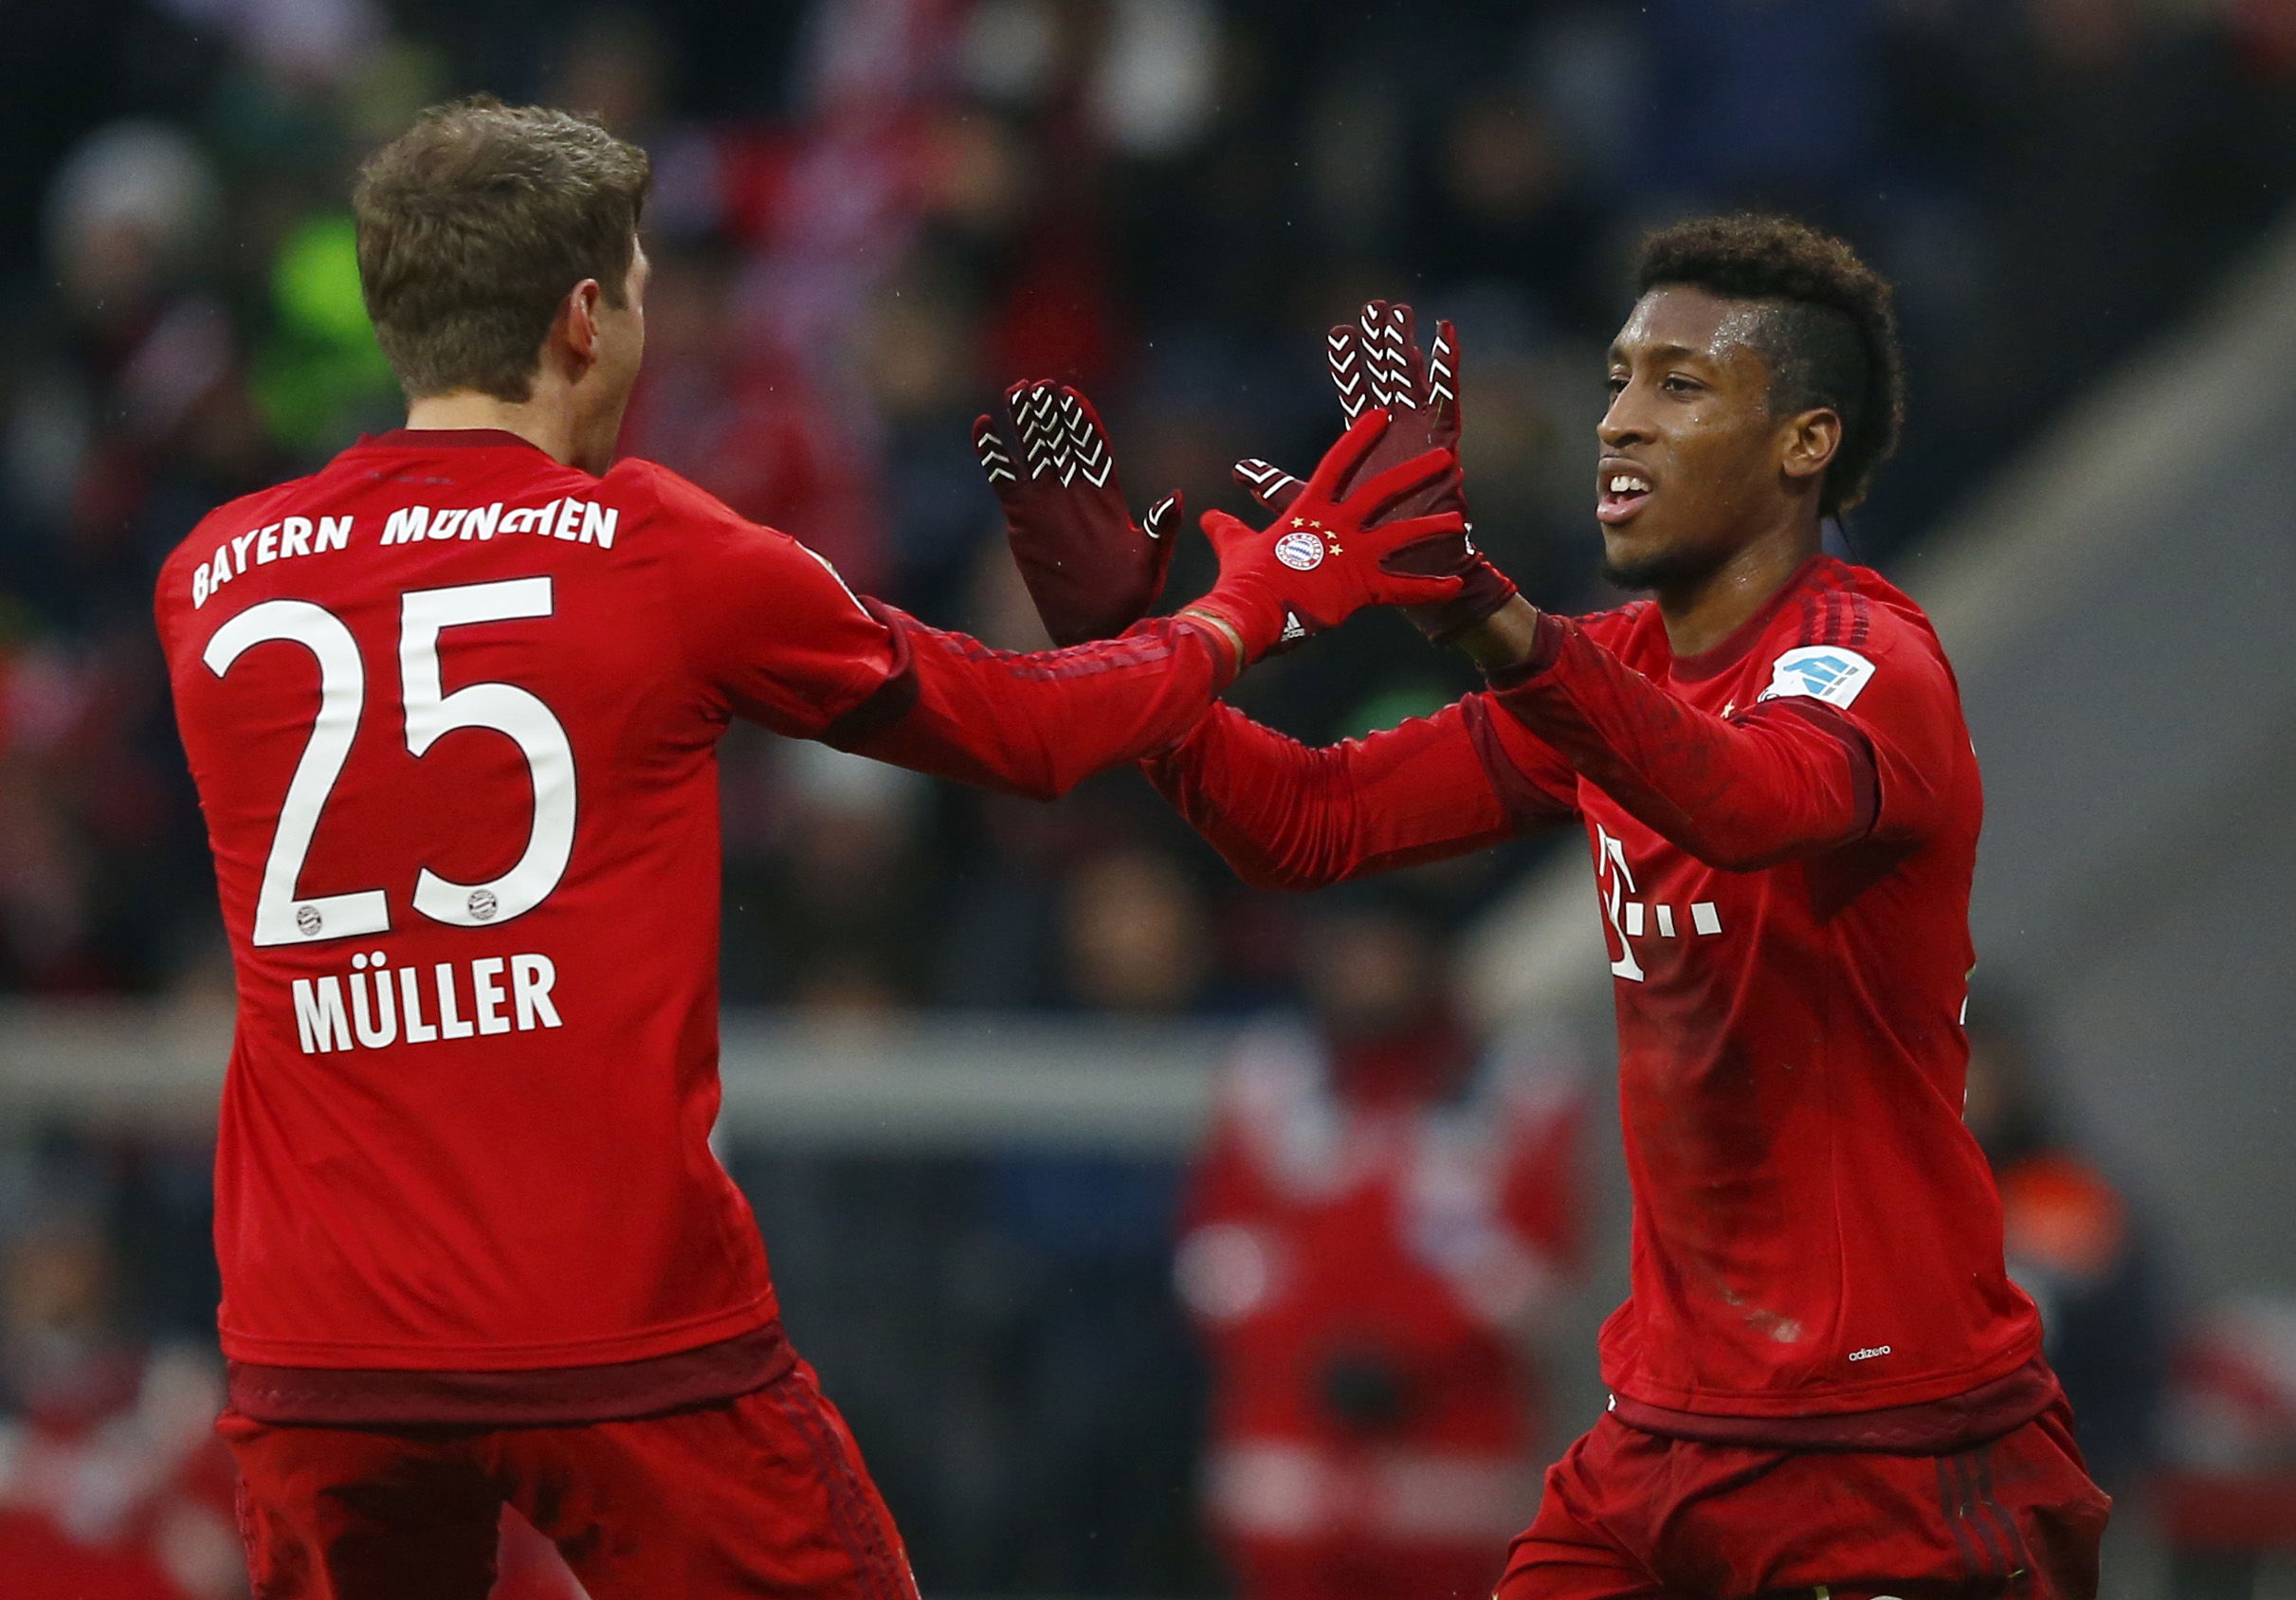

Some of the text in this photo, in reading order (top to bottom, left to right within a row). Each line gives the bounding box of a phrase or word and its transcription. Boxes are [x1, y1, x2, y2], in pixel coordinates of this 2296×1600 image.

[192, 516, 354, 609] BAYERN
[202, 575, 577, 947] 25
[291, 951, 563, 1055] MÜLLER
[1849, 1345, 1891, 1361] adizero
